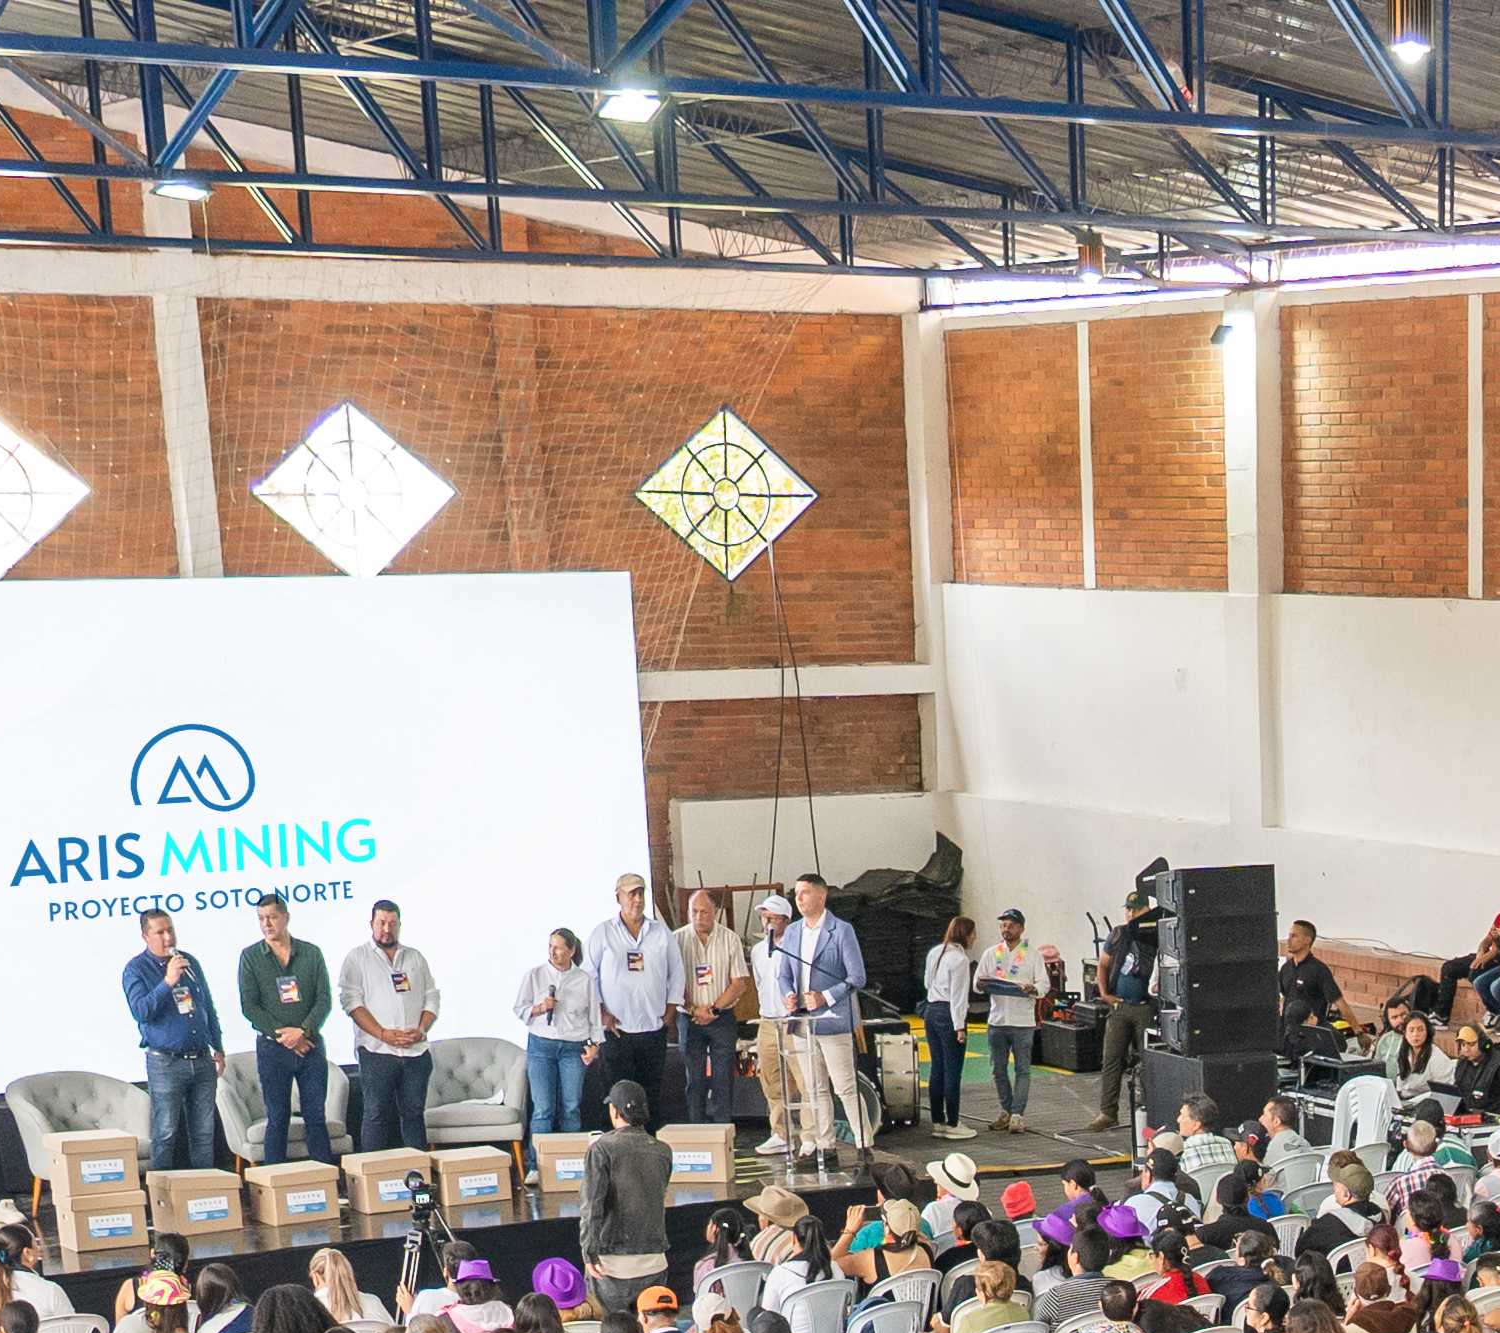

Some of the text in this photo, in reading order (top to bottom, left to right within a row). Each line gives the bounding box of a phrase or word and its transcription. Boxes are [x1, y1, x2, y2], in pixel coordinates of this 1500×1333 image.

[10, 817, 377, 887] ARIS MINING
[49, 880, 354, 922] PROYECTO SOTO NORTE
